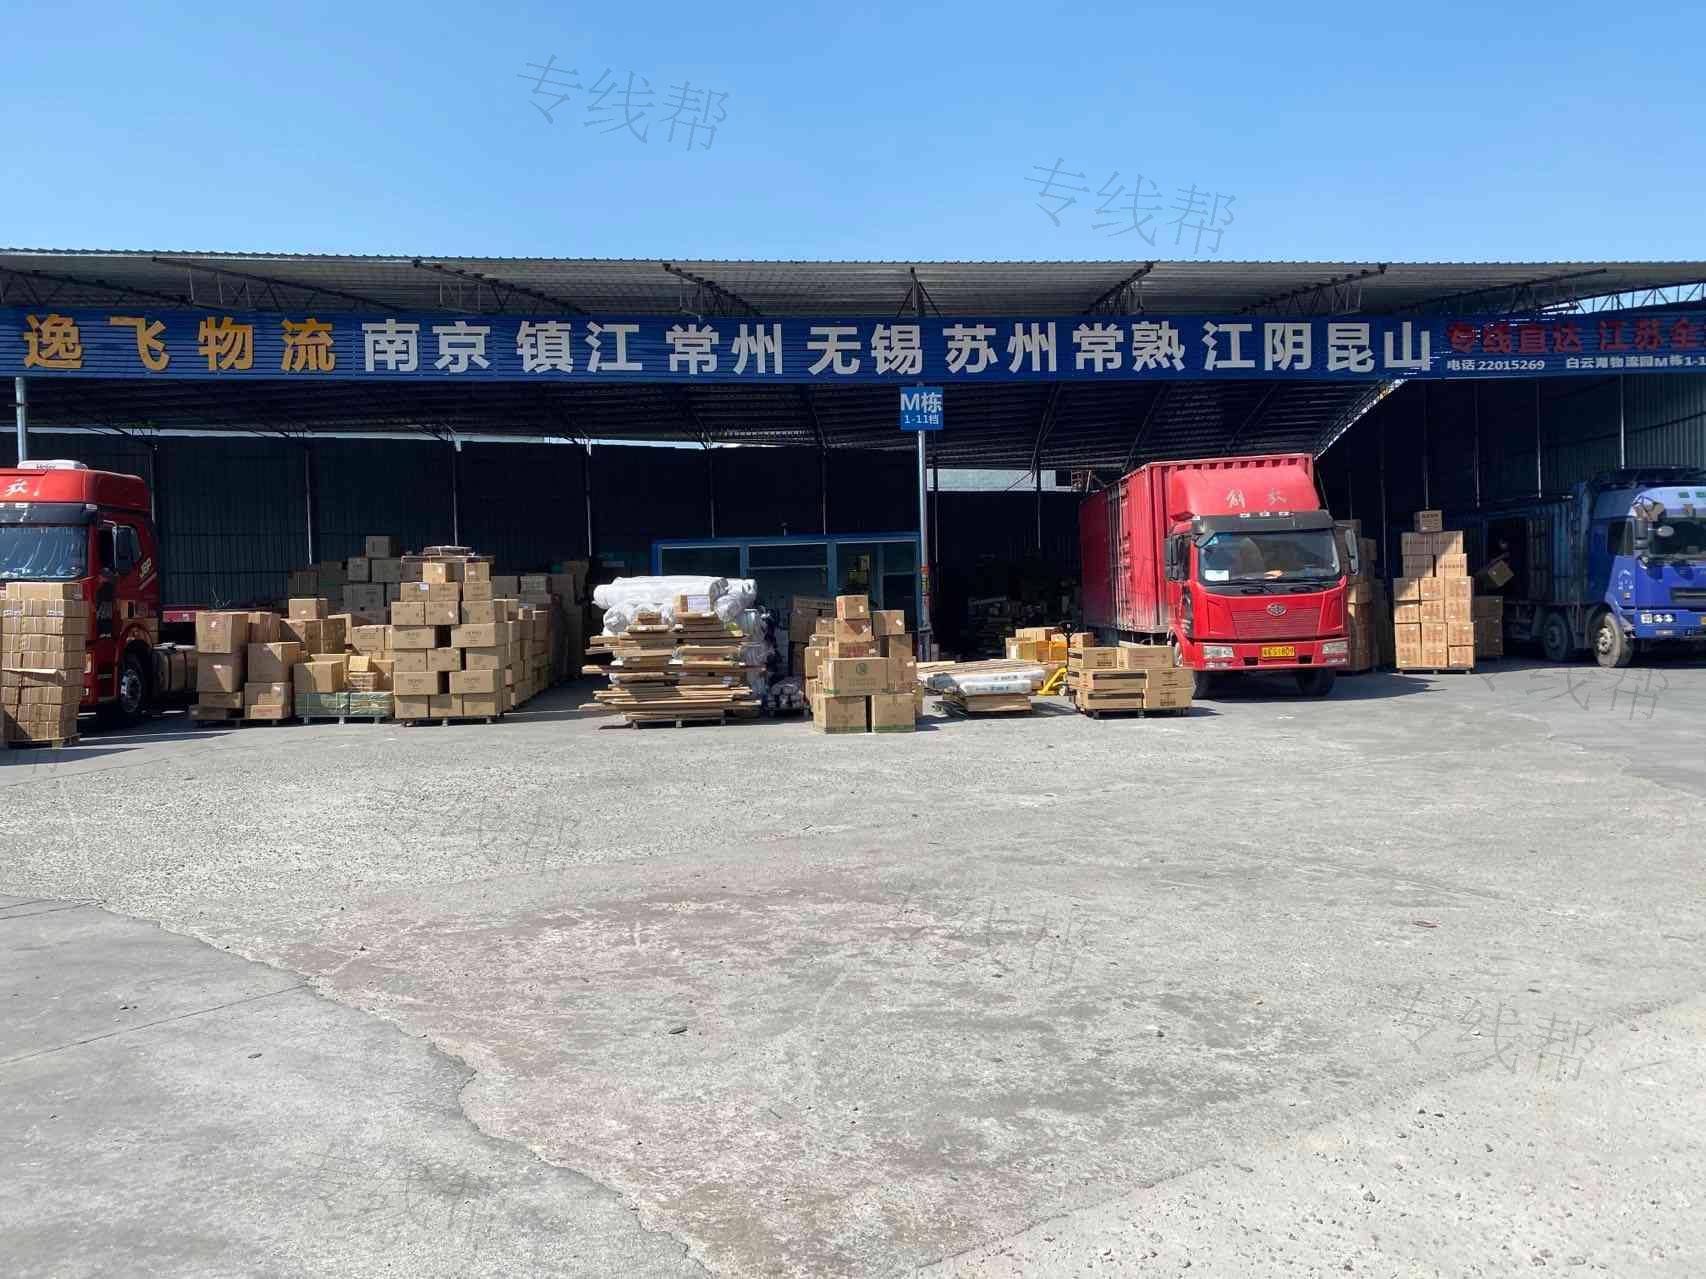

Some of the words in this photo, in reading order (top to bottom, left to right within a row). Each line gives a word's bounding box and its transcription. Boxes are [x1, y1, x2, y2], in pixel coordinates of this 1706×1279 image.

[23, 313, 336, 372] 逸飞物流
[900, 391, 943, 413] M栋
